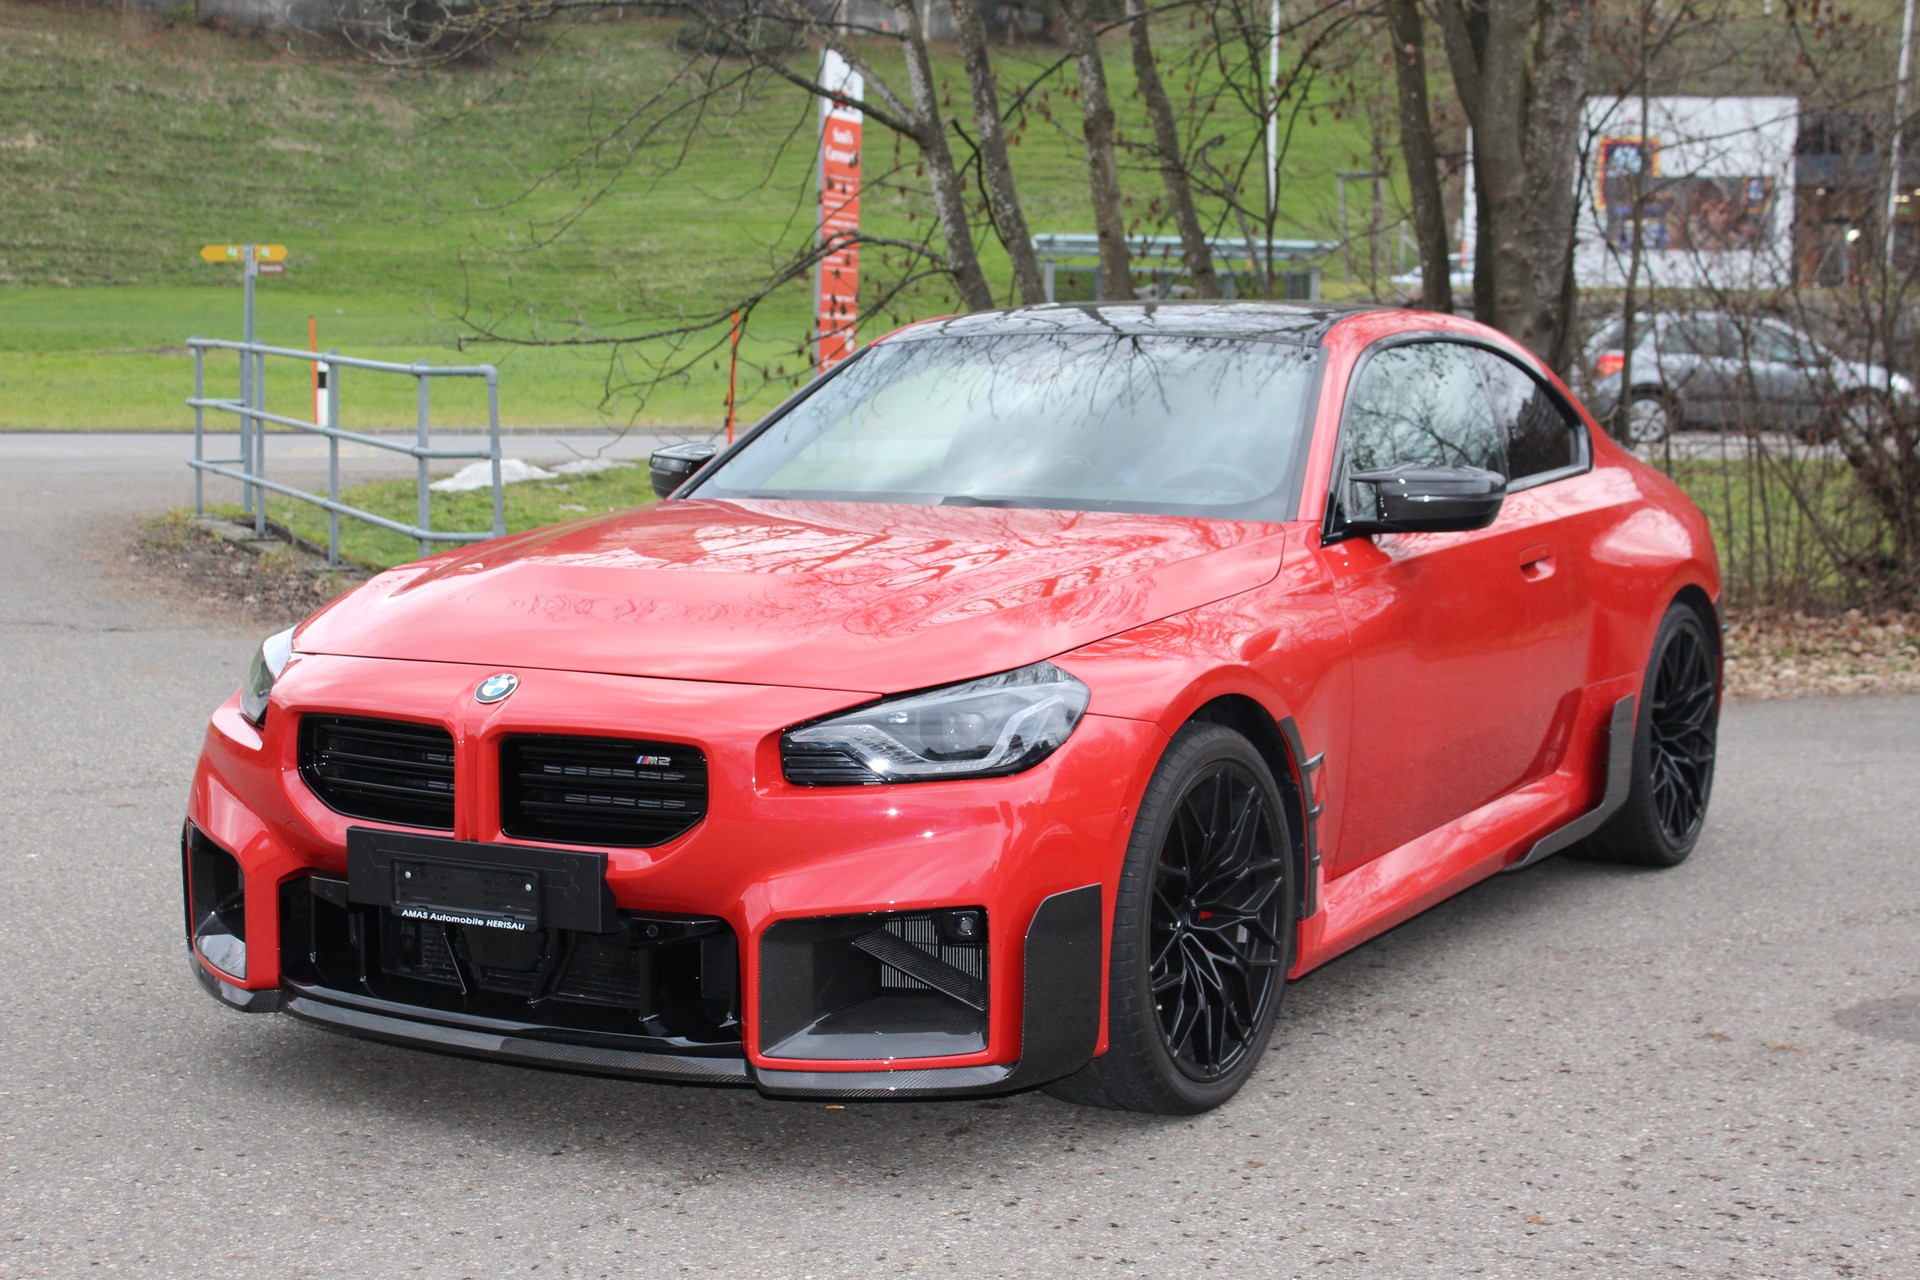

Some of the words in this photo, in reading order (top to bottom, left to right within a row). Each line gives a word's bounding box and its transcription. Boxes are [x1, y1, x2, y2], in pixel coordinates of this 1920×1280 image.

[646, 756, 671, 765] M2
[402, 909, 428, 919] AMAS
[430, 912, 484, 925] Automobile
[486, 919, 525, 930] HERISAU
